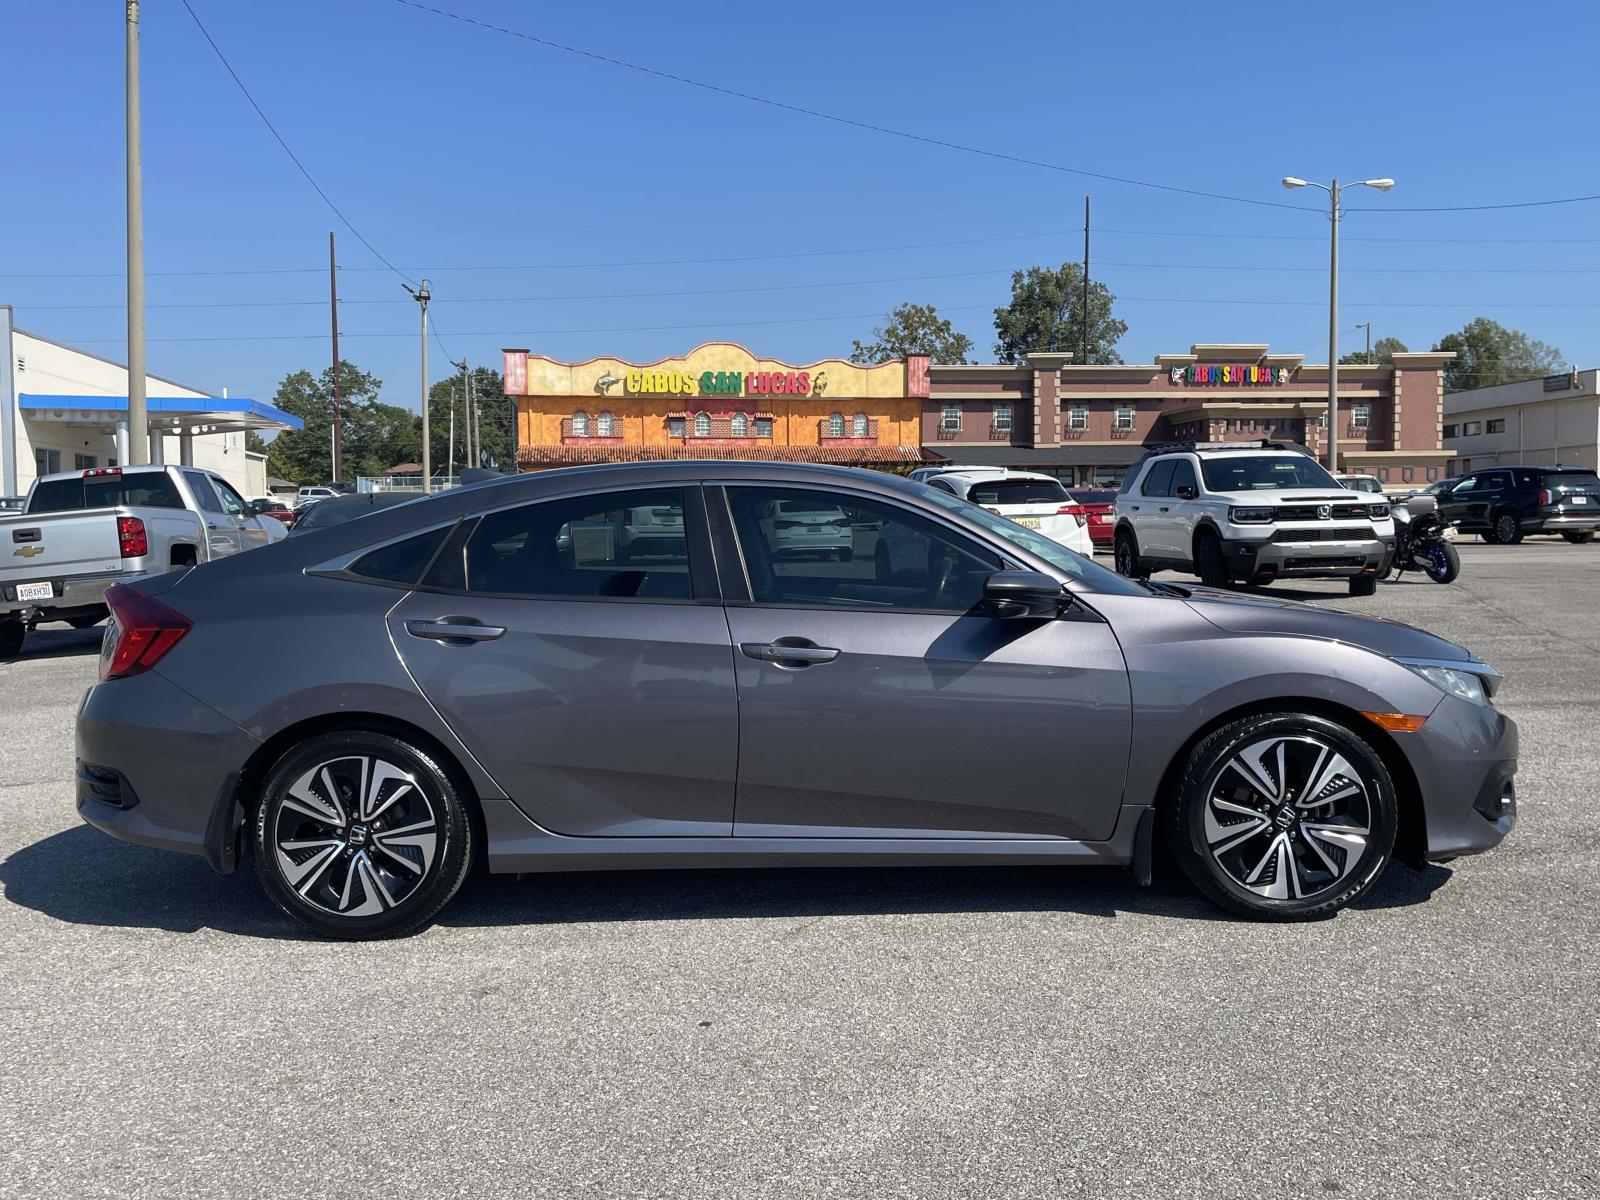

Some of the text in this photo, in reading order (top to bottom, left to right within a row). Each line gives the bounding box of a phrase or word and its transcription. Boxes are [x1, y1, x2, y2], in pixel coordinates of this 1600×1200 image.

[626, 371, 810, 393] CABOS SAN LUCAS
[1187, 365, 1278, 384] CABOS SAN LUCAS
